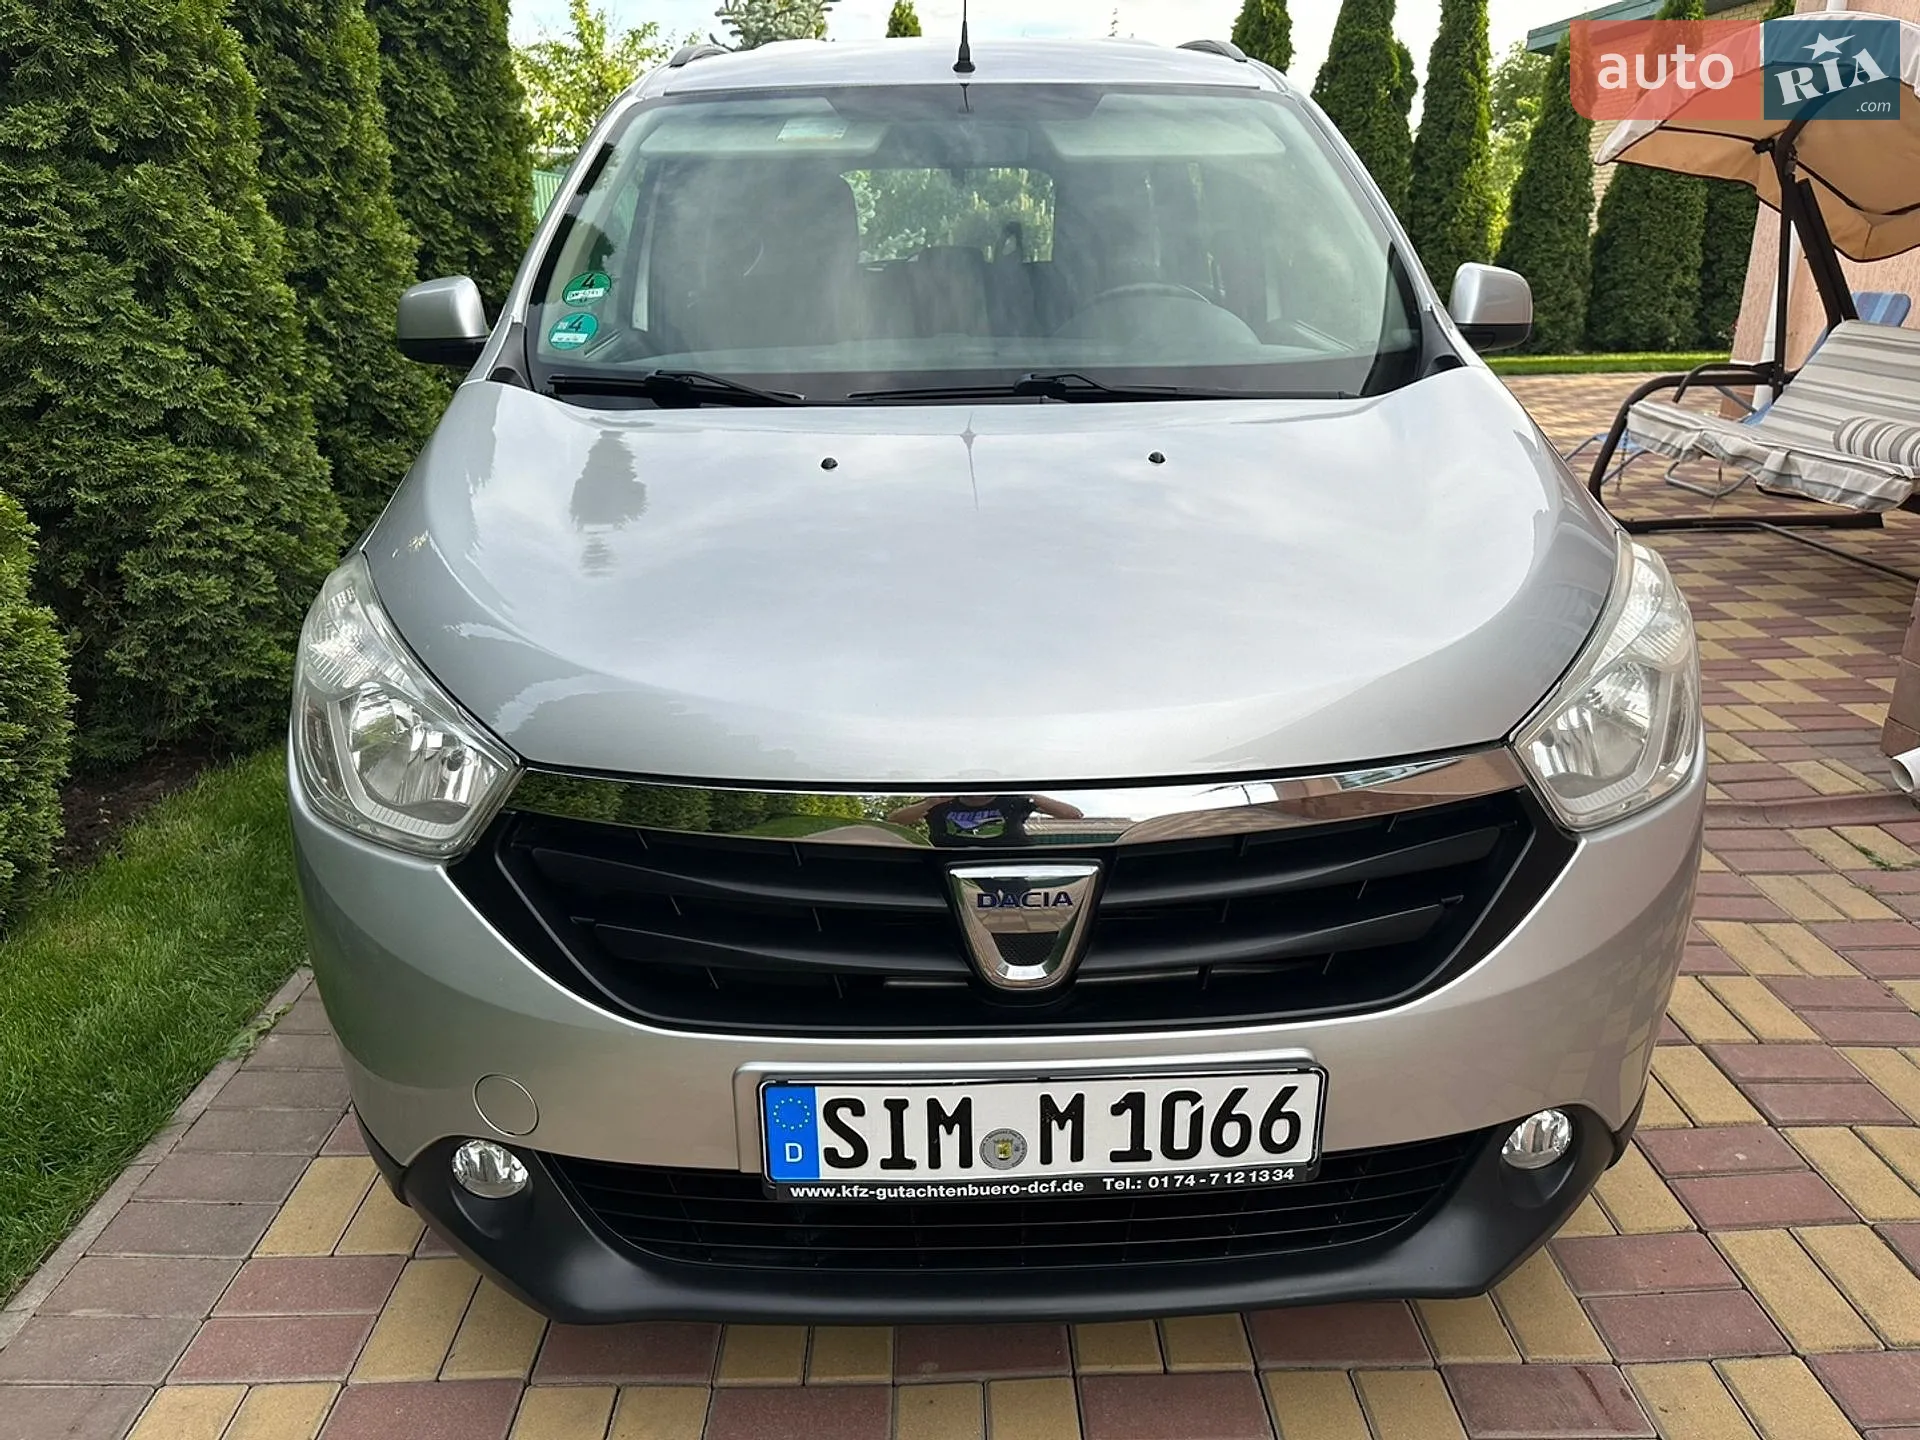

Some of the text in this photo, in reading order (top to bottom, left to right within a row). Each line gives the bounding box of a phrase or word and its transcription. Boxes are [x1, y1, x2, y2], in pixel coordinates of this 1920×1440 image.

[581, 273, 595, 289] 4
[568, 314, 584, 332] 4
[976, 890, 1073, 908] DACIA
[822, 1096, 973, 1171] SIM
[1039, 1092, 1085, 1166] M
[1109, 1085, 1301, 1163] 1066
[784, 1142, 803, 1163] D
[789, 1179, 1084, 1201] www.kfz-gutachtenbuero-dcf.de
[1102, 1177, 1142, 1191] Tel.:
